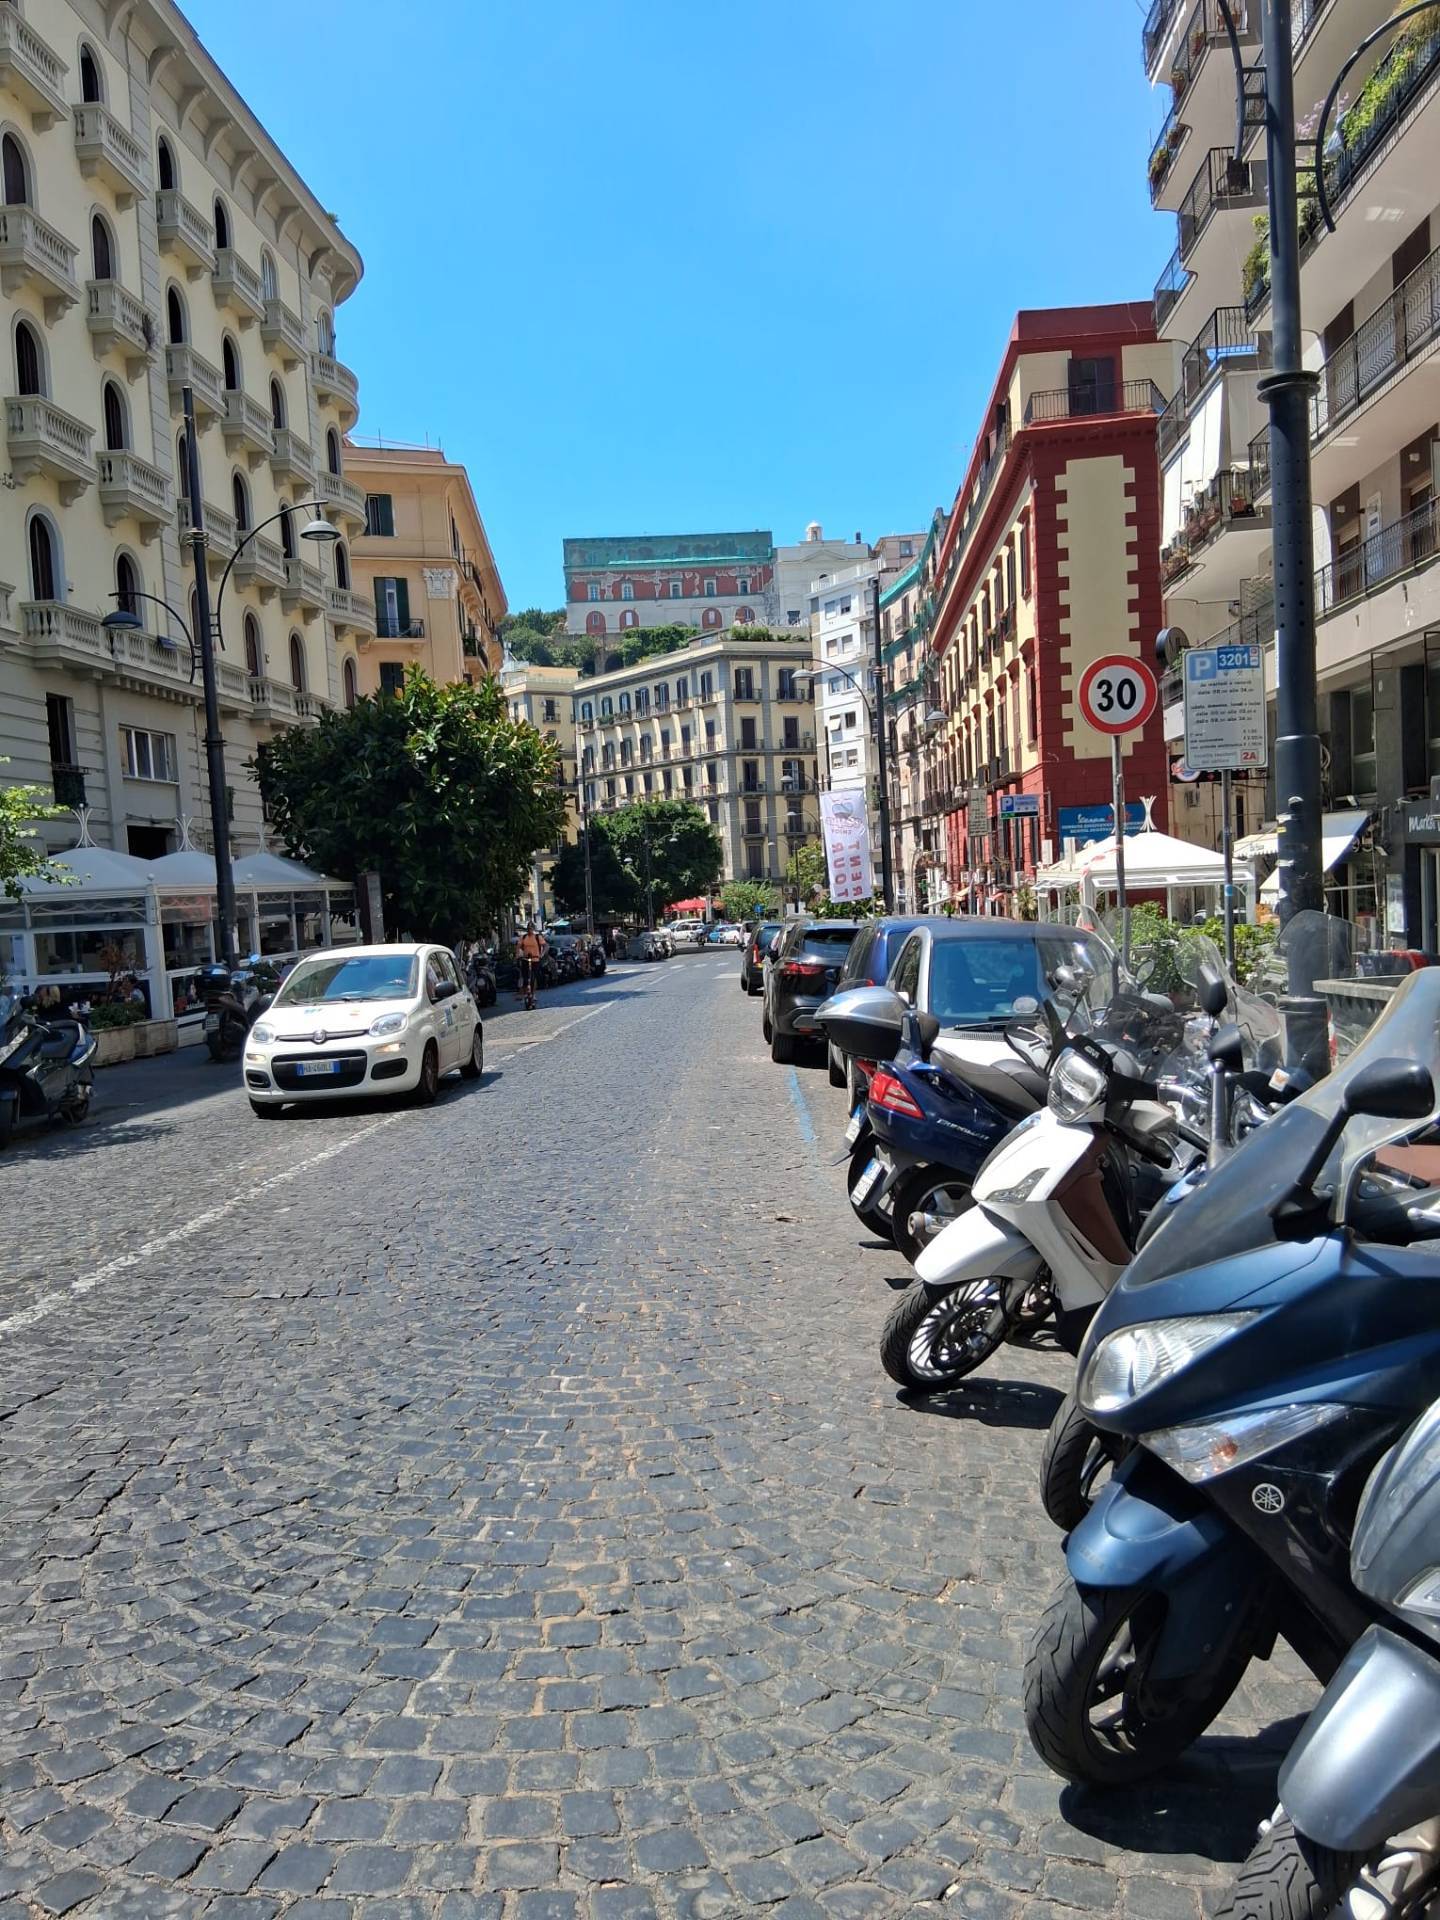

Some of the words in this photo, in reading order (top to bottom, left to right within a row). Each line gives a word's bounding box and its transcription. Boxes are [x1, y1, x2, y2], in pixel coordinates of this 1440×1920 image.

[1195, 657, 1211, 677] P
[1219, 653, 1249, 667] 3201
[1097, 678, 1136, 712] 30
[1242, 751, 1256, 760] 2A
